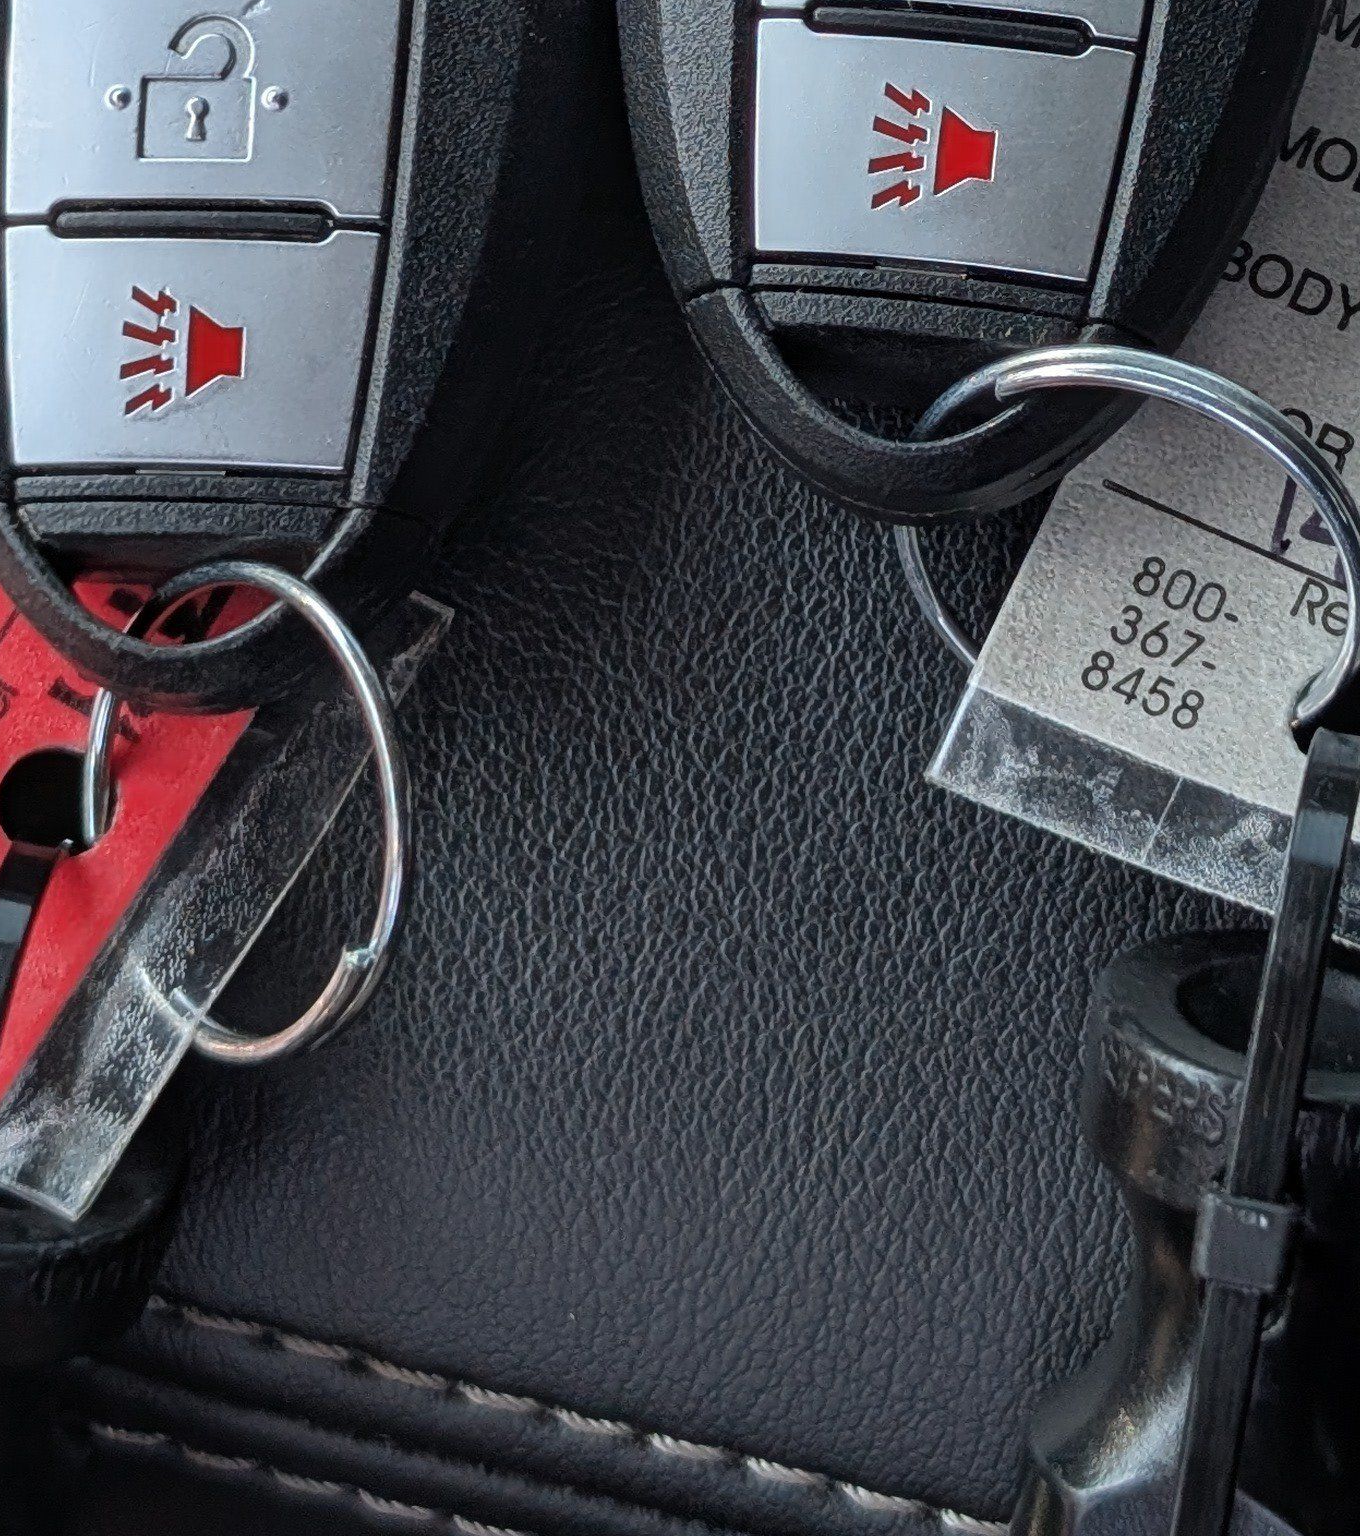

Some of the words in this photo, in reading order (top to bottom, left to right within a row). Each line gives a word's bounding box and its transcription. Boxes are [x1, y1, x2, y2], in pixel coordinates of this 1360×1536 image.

[1131, 556, 1240, 626] 800-
[1110, 604, 1218, 675] 367-
[1080, 650, 1206, 731] 8458
